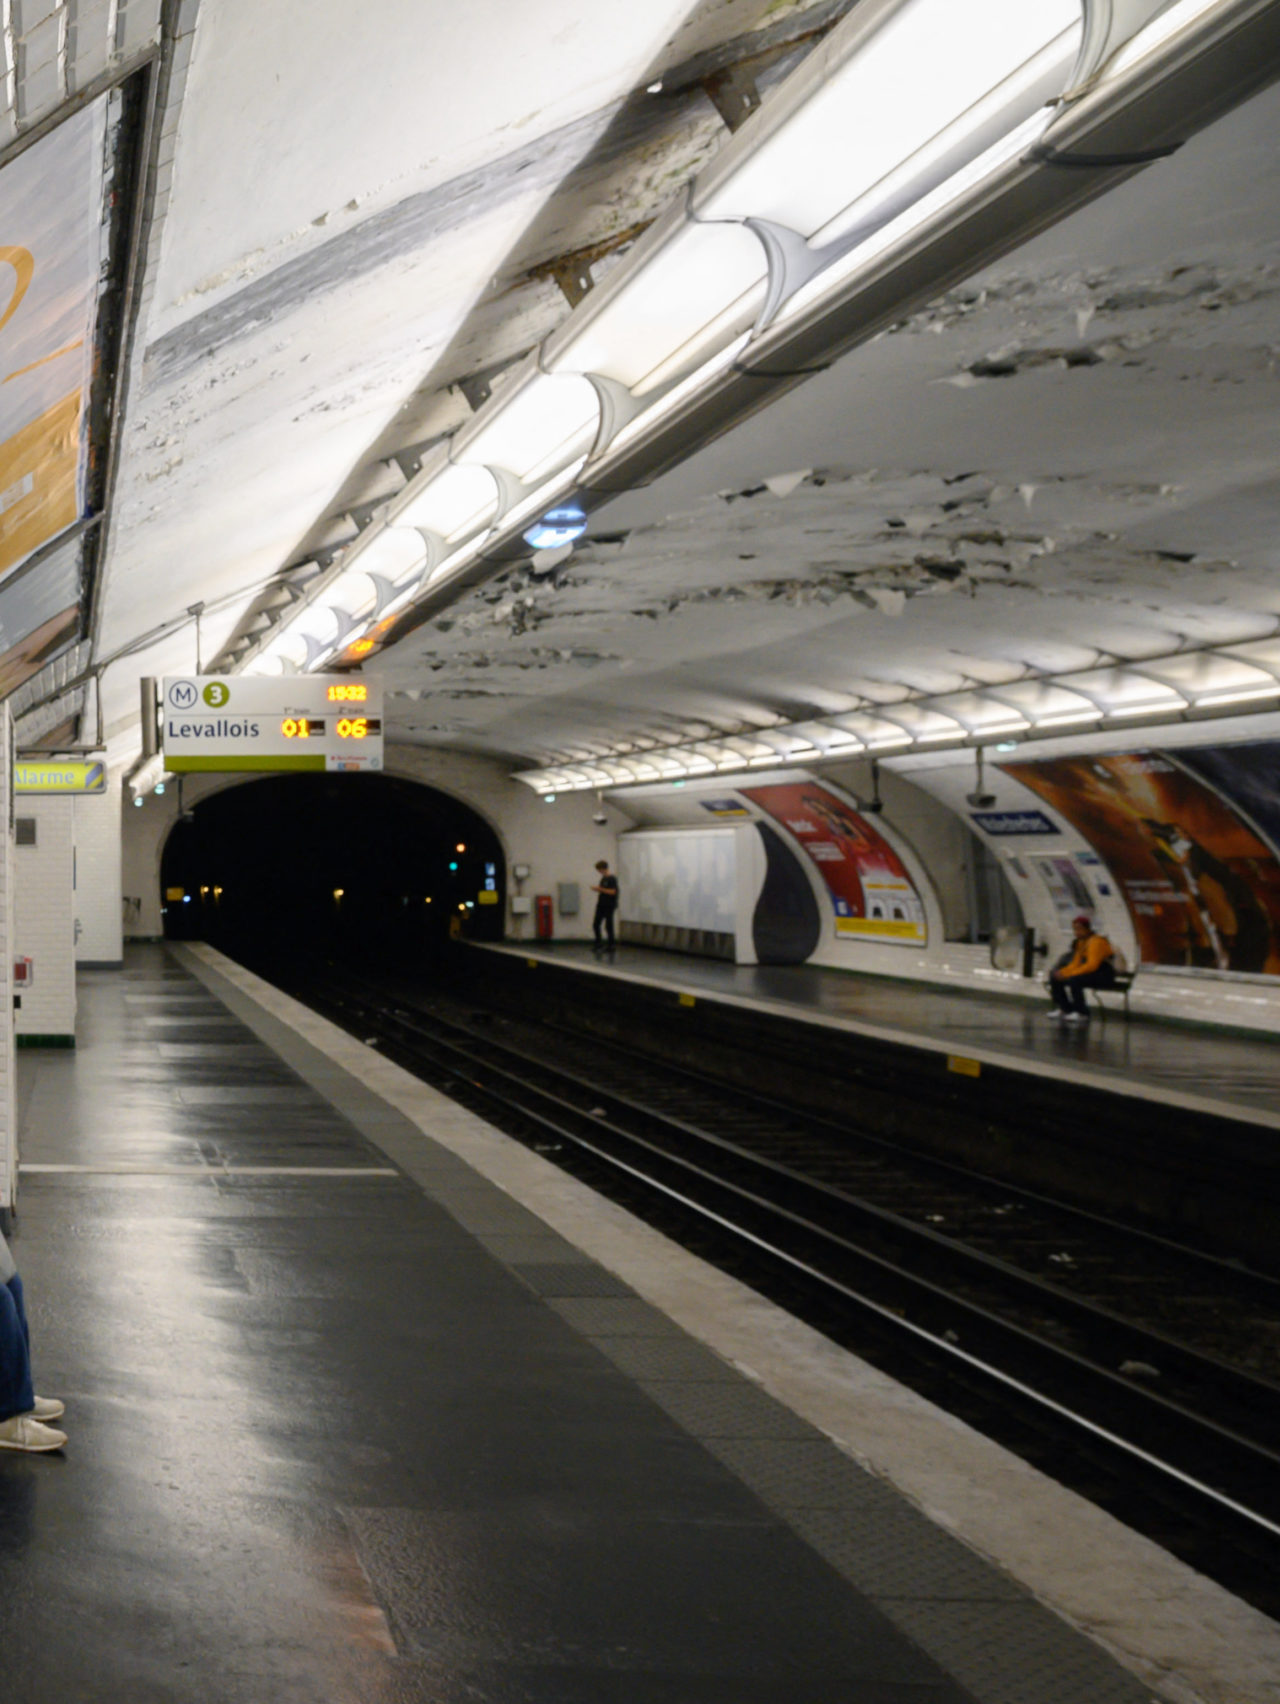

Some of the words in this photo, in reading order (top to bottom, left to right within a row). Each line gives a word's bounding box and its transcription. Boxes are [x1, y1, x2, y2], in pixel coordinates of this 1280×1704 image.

[209, 685, 223, 705] 3
[169, 720, 260, 738] Levallois
[281, 717, 309, 739] 01
[336, 717, 367, 739] 06
